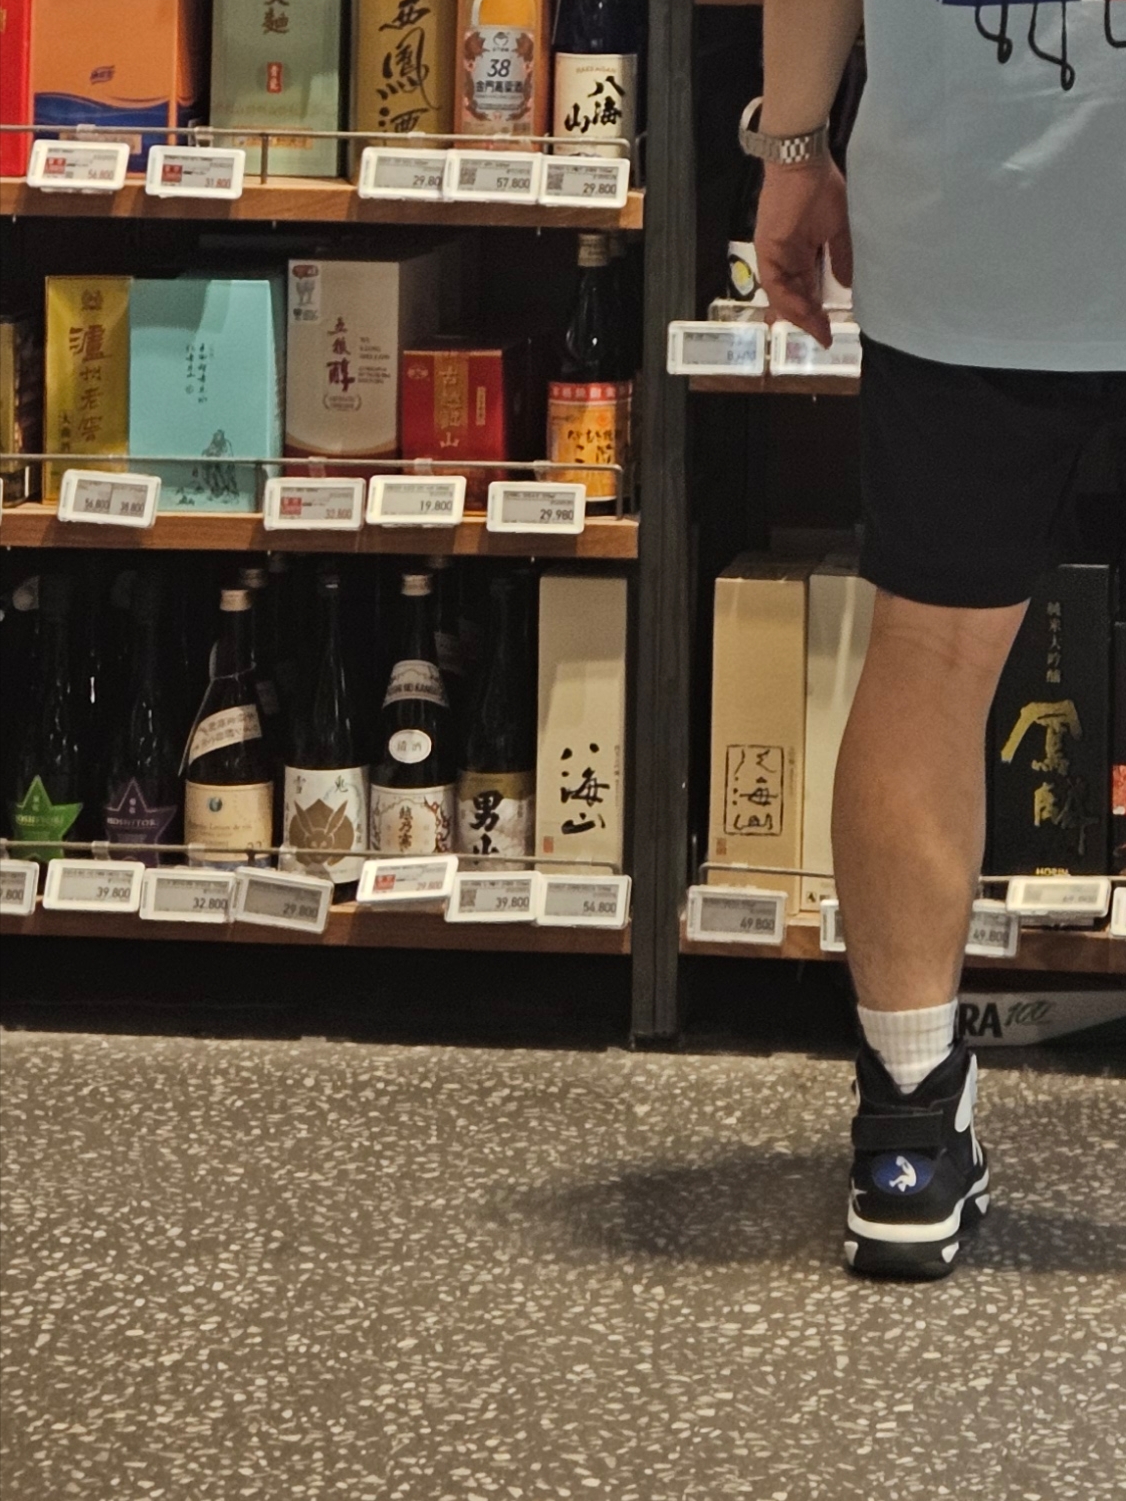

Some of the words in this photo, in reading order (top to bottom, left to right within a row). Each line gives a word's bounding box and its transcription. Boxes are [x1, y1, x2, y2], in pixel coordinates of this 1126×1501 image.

[487, 58, 512, 77] 38
[497, 177, 530, 188] 57.800
[583, 182, 617, 194] 29.800
[420, 500, 452, 511] 19.800
[540, 508, 573, 520] 29.980
[560, 742, 611, 835] 八海山
[97, 887, 130, 897] 39.800
[193, 897, 227, 908] 32.800
[496, 897, 529, 909] 39.800
[740, 918, 775, 932] 49.800
